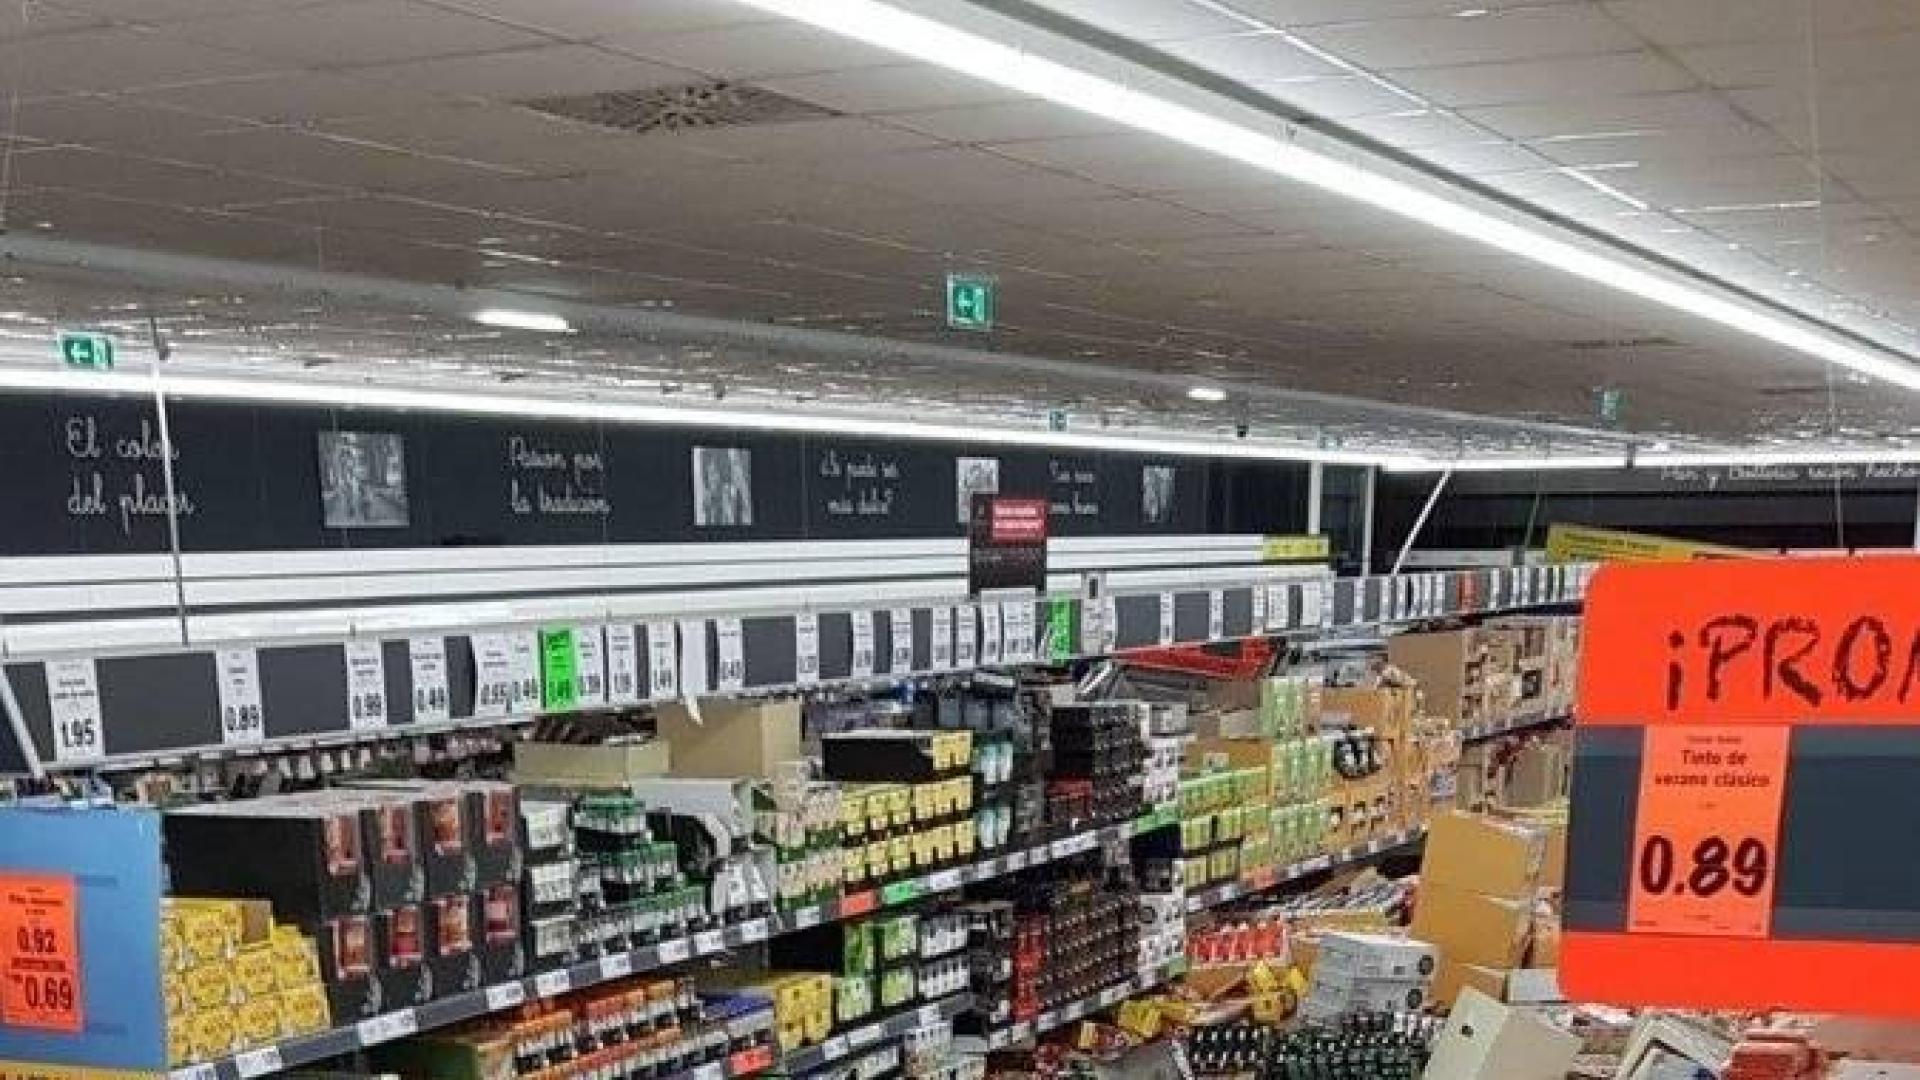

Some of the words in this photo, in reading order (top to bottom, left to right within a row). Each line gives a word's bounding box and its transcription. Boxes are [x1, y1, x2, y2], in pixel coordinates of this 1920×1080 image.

[66, 416, 101, 458] El
[68, 471, 106, 514] del
[511, 480, 532, 514] la
[61, 718, 96, 748] 1.95
[1681, 749, 1721, 765] Tinto
[1726, 749, 1748, 765] de
[1654, 773, 1708, 786] verano
[1714, 770, 1770, 788] clásico
[1640, 834, 1767, 898] 0.89
[25, 976, 73, 1011] 0.69
